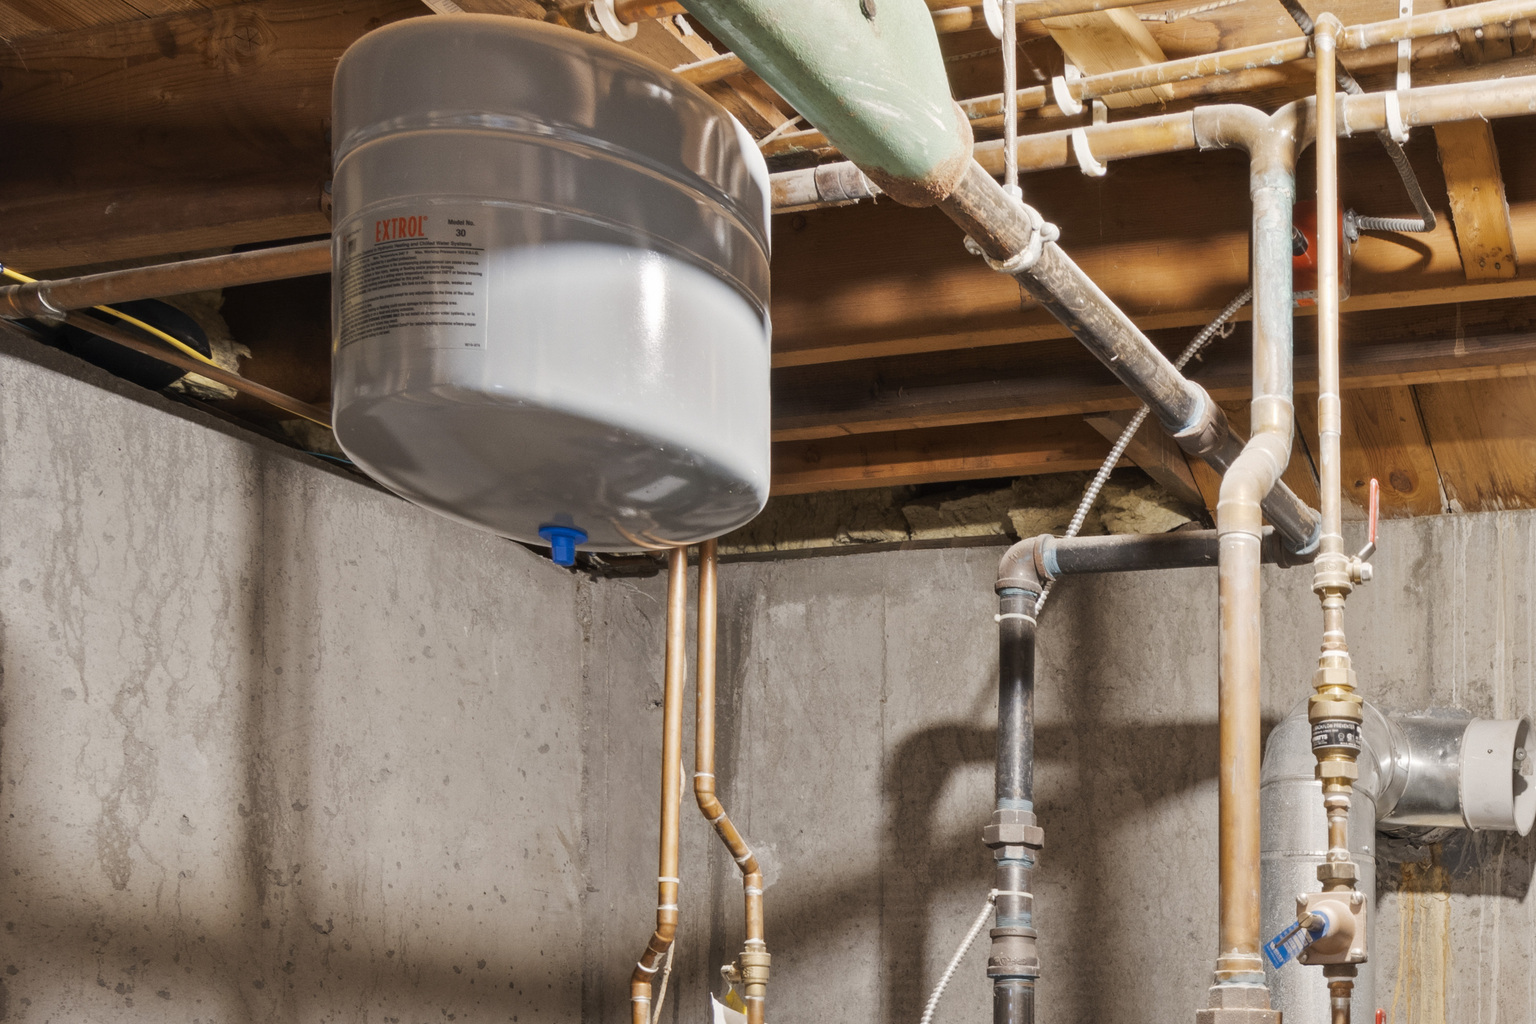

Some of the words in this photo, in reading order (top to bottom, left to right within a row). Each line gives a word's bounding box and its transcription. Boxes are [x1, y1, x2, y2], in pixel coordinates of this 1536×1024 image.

[447, 218, 464, 226] Model
[466, 219, 476, 227] No.
[455, 228, 466, 238] 30
